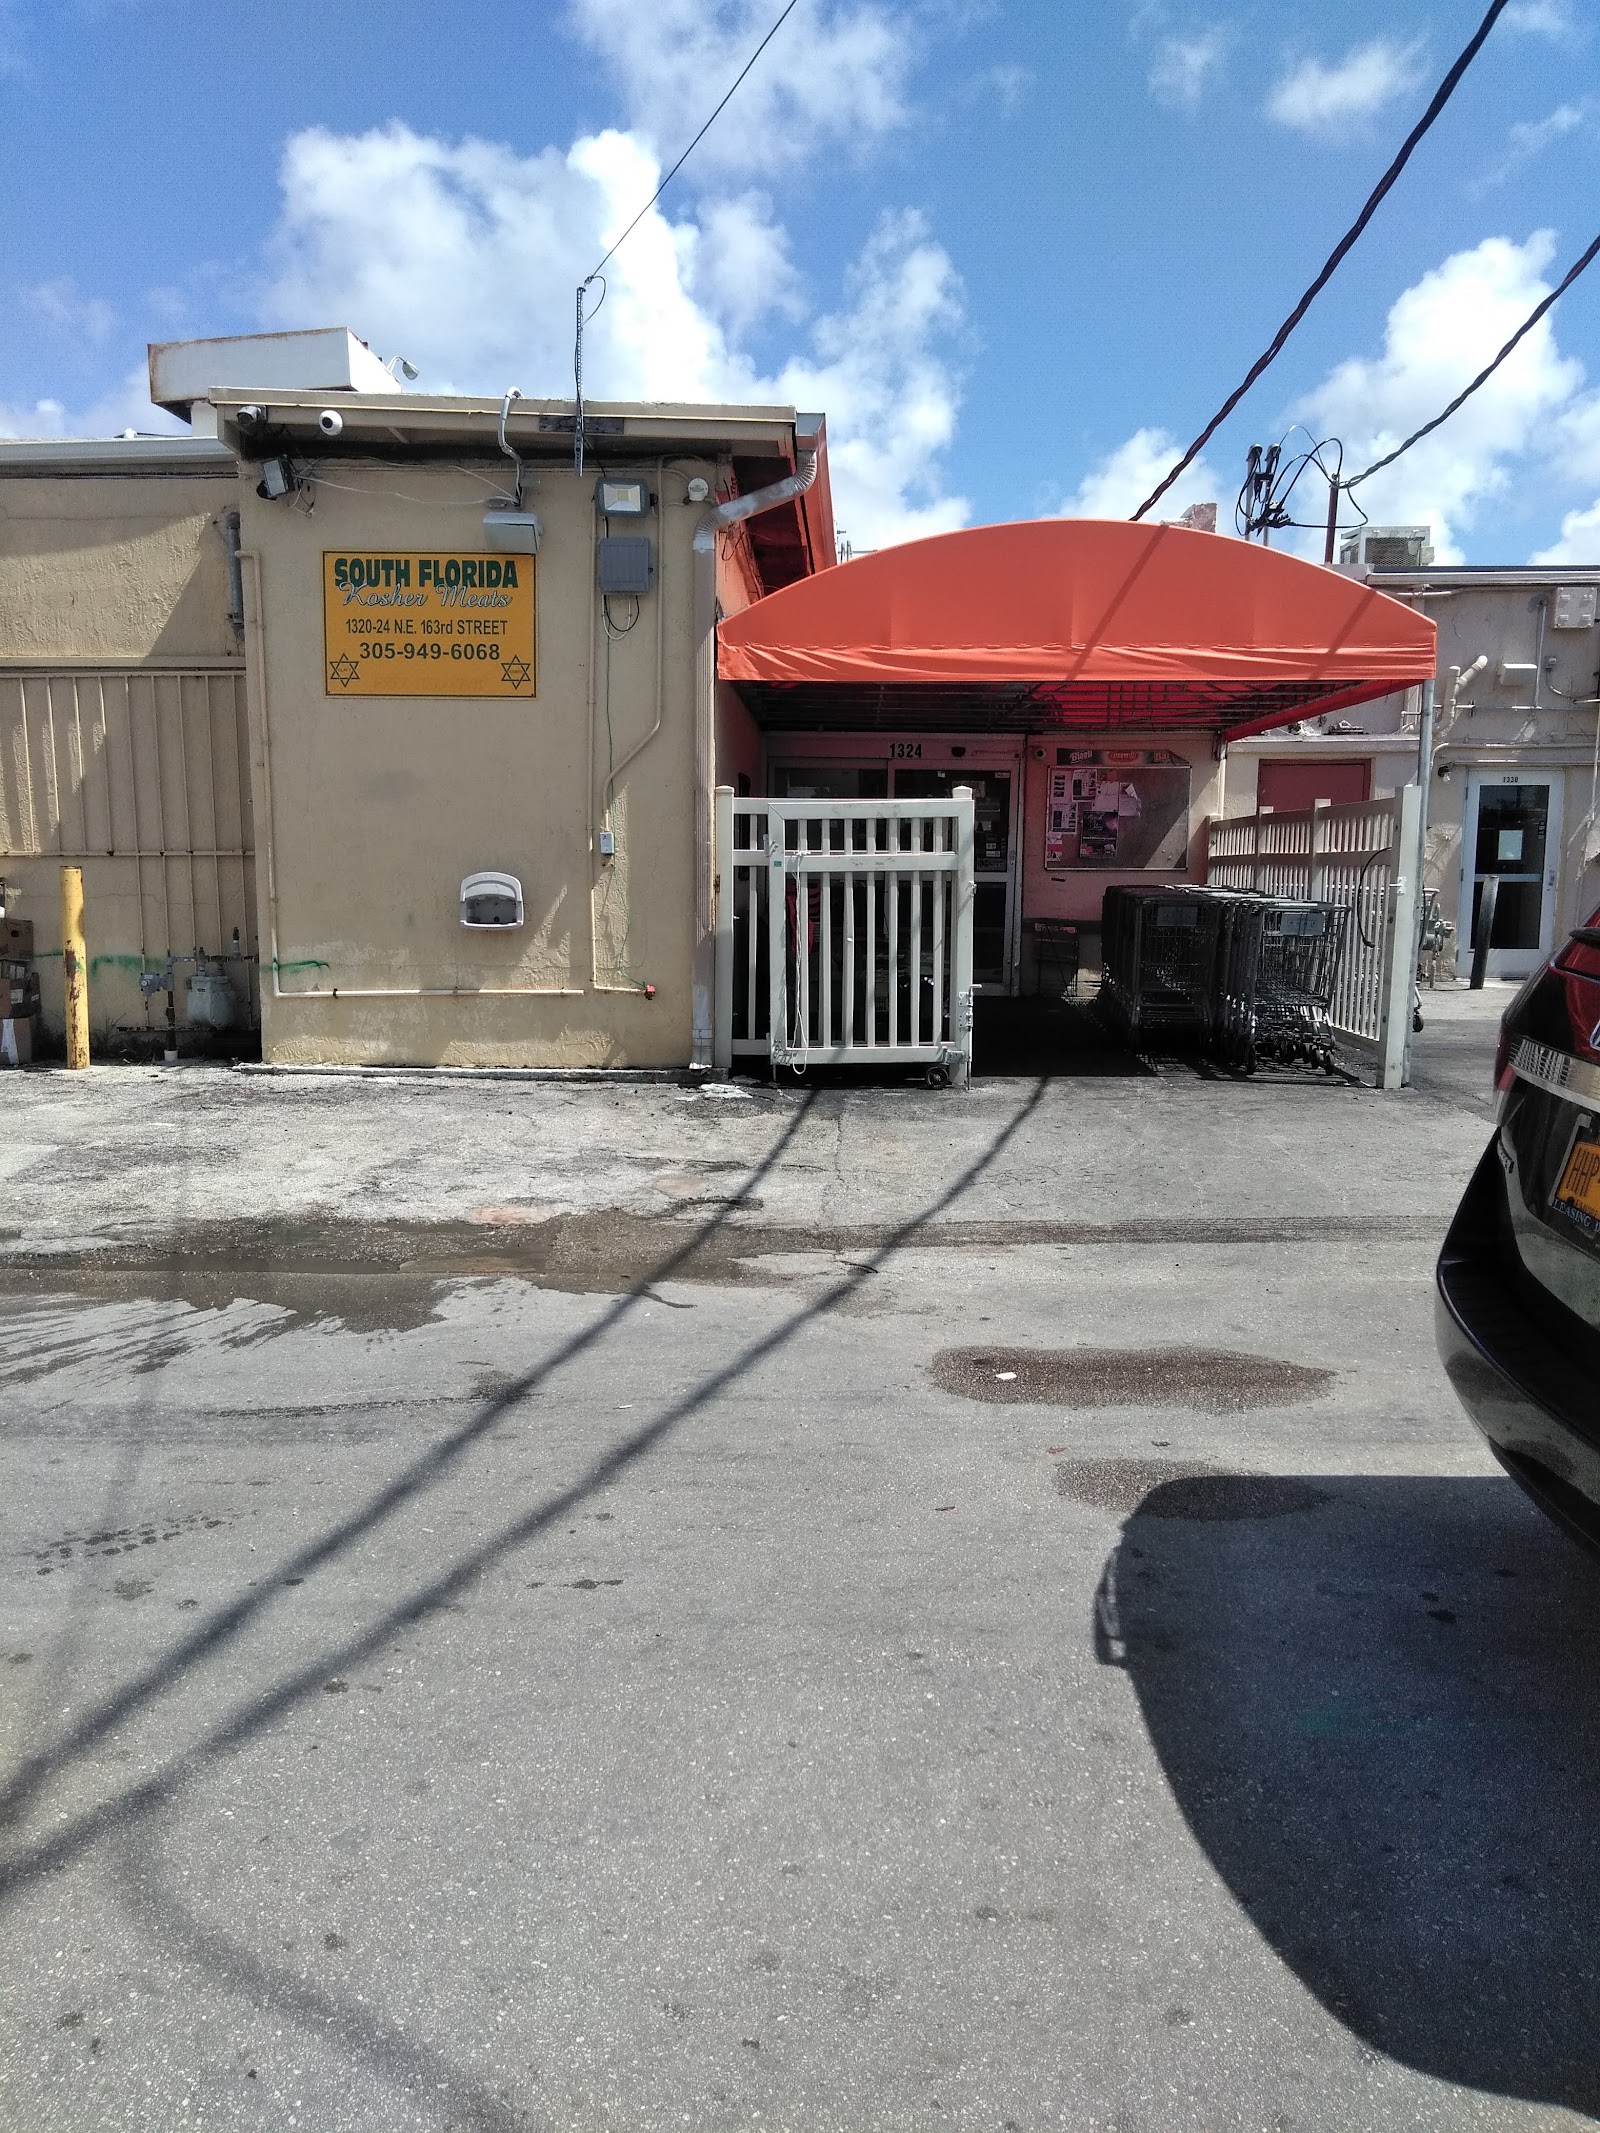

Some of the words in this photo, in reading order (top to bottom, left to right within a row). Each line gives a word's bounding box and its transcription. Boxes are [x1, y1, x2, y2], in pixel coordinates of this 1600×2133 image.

[334, 557, 411, 588] SOUTH
[418, 559, 519, 589] FLORIDA
[339, 581, 429, 607] Kosher
[435, 583, 514, 608] Meats
[345, 618, 391, 635] 1320-24
[394, 619, 418, 635] N.E.
[420, 619, 454, 635] 163rd
[456, 620, 508, 636] STREET
[359, 642, 501, 661] 305-949-6068
[889, 743, 923, 758] 1324
[1552, 1198, 1591, 1227] LEASING
